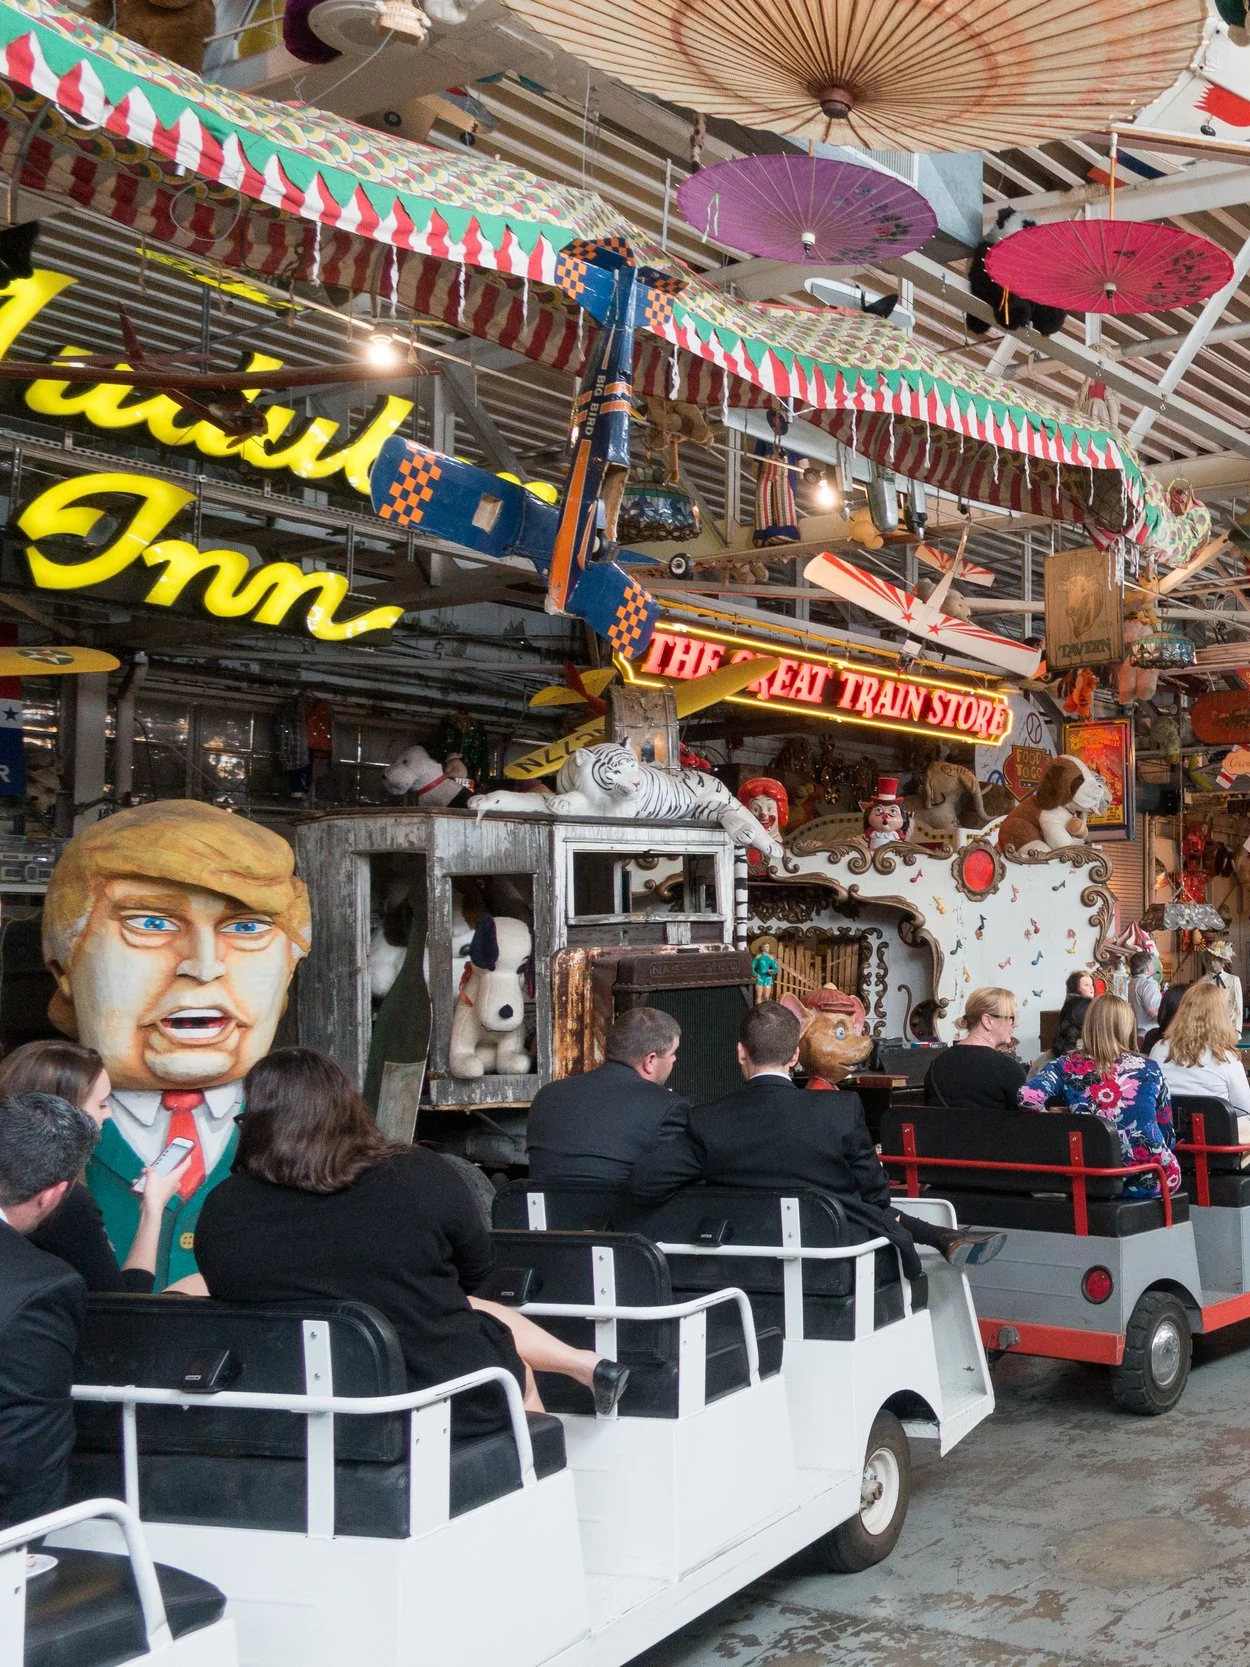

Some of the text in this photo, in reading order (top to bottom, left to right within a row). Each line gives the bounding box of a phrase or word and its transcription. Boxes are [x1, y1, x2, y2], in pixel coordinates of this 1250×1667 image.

[585, 375, 606, 435] BIG BIRD
[17, 472, 405, 641] Inn
[1059, 638, 1112, 658] TAVERN
[642, 631, 727, 681] THE
[837, 670, 930, 722] TRAIN
[928, 688, 1010, 738] STORE
[1015, 748, 1042, 765] FOOD
[1015, 764, 1029, 777] TO
